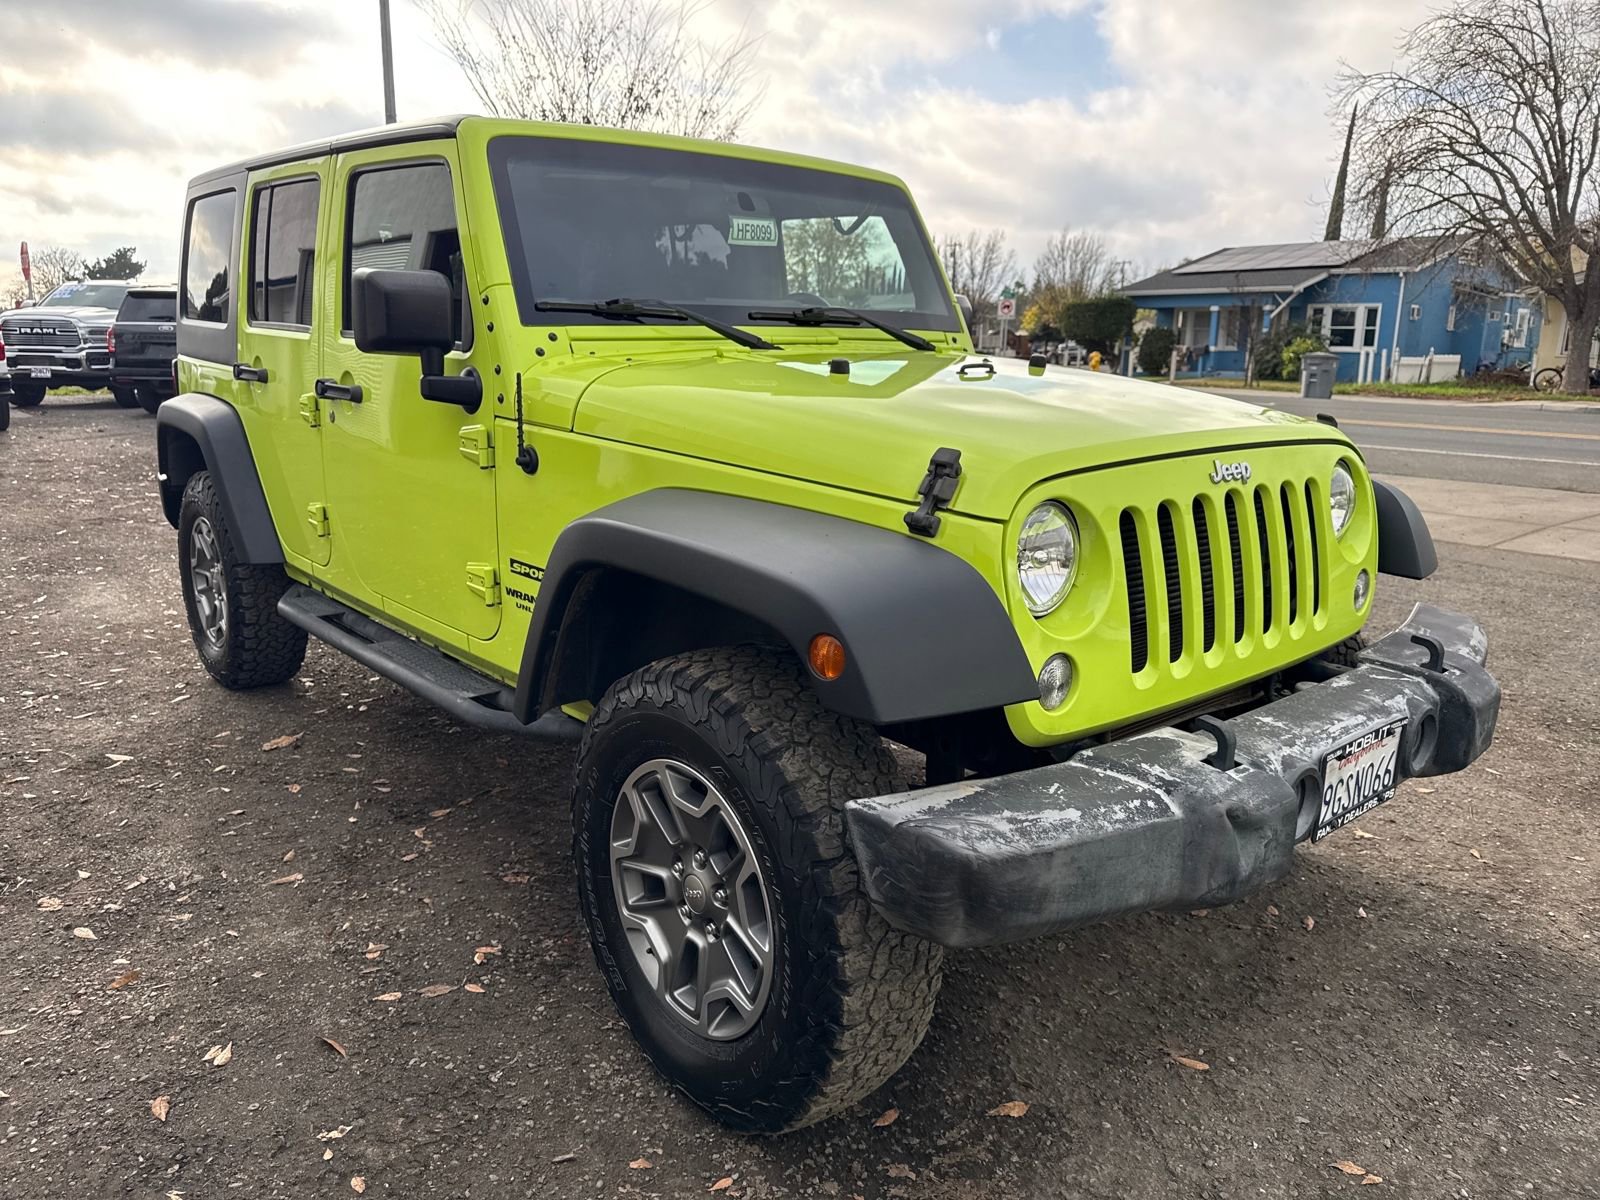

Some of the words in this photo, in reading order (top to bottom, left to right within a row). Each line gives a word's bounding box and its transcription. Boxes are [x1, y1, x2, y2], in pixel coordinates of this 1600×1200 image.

[736, 223, 772, 241] HF8099
[1209, 459, 1252, 485] Jeep
[1345, 724, 1392, 755] HOBLIT
[1319, 750, 1396, 826] 9GSN066
